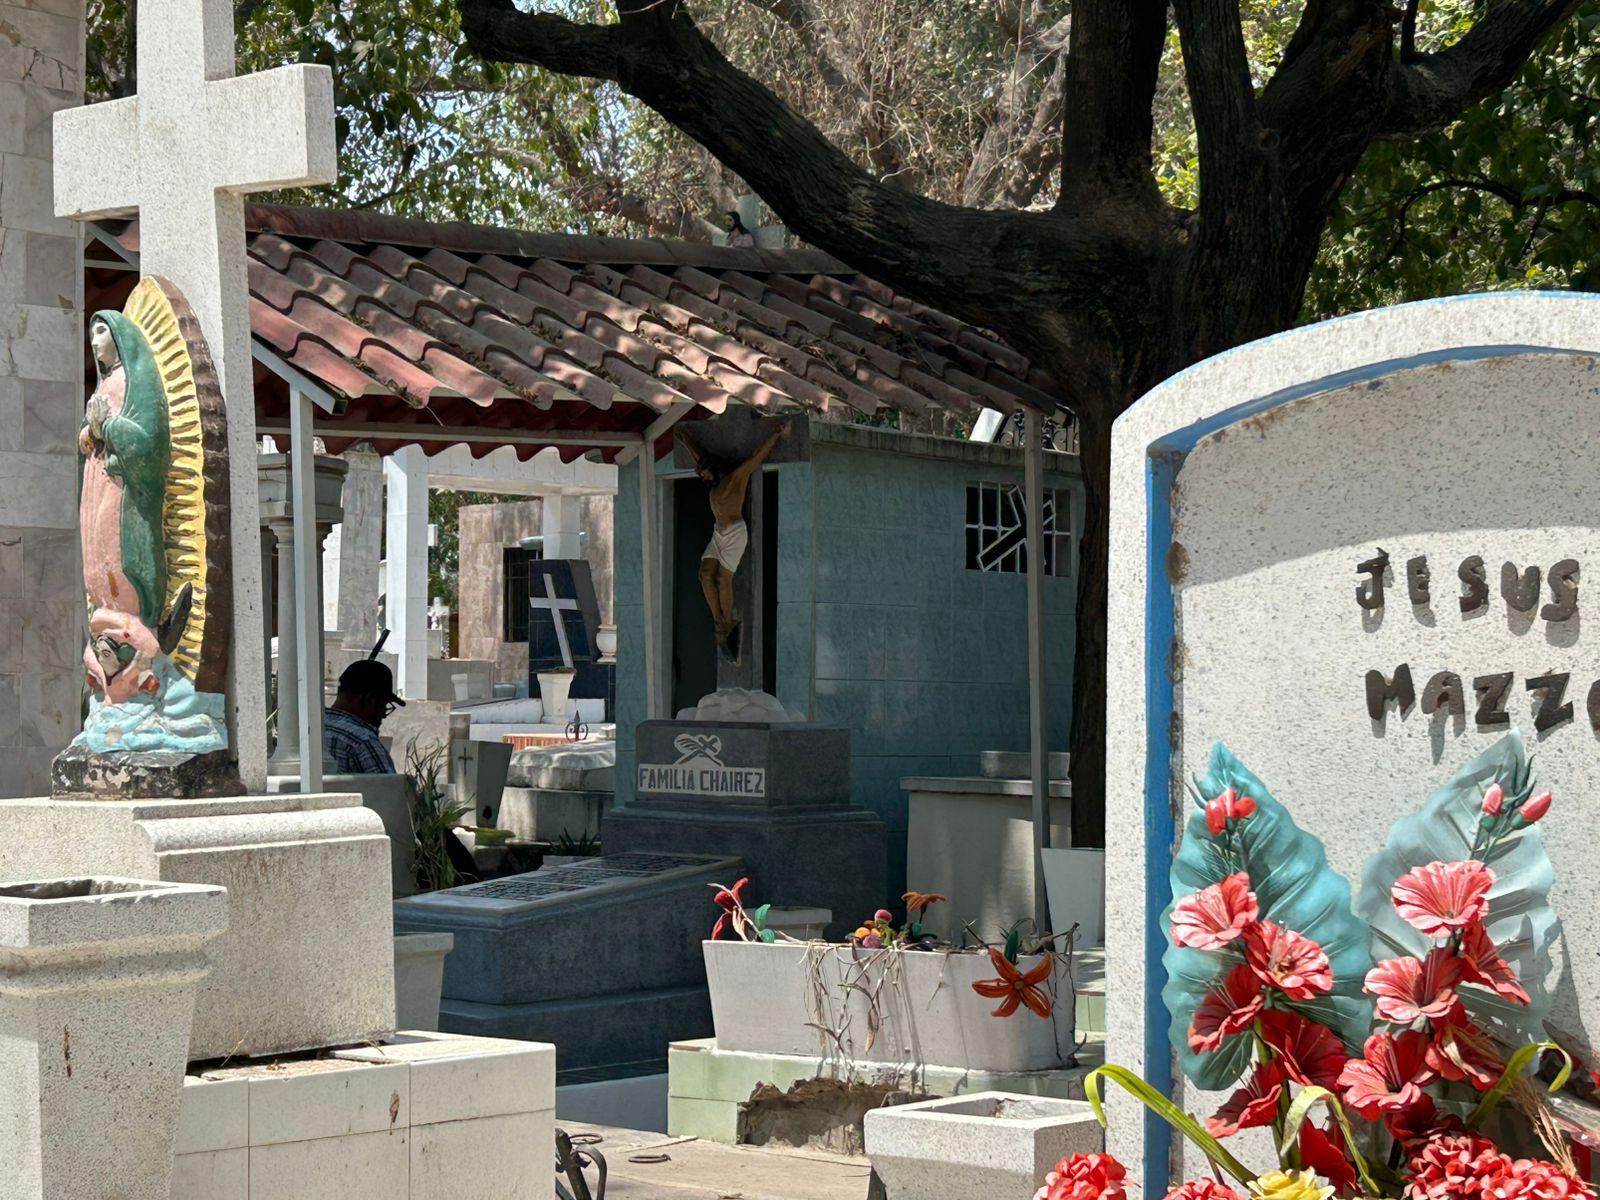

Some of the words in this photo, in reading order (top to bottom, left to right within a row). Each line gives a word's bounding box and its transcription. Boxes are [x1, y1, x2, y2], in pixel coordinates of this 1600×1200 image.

[1355, 547, 1580, 622] JESUS
[639, 767, 696, 790] FAMILIA
[699, 769, 764, 794] CHAIREZ
